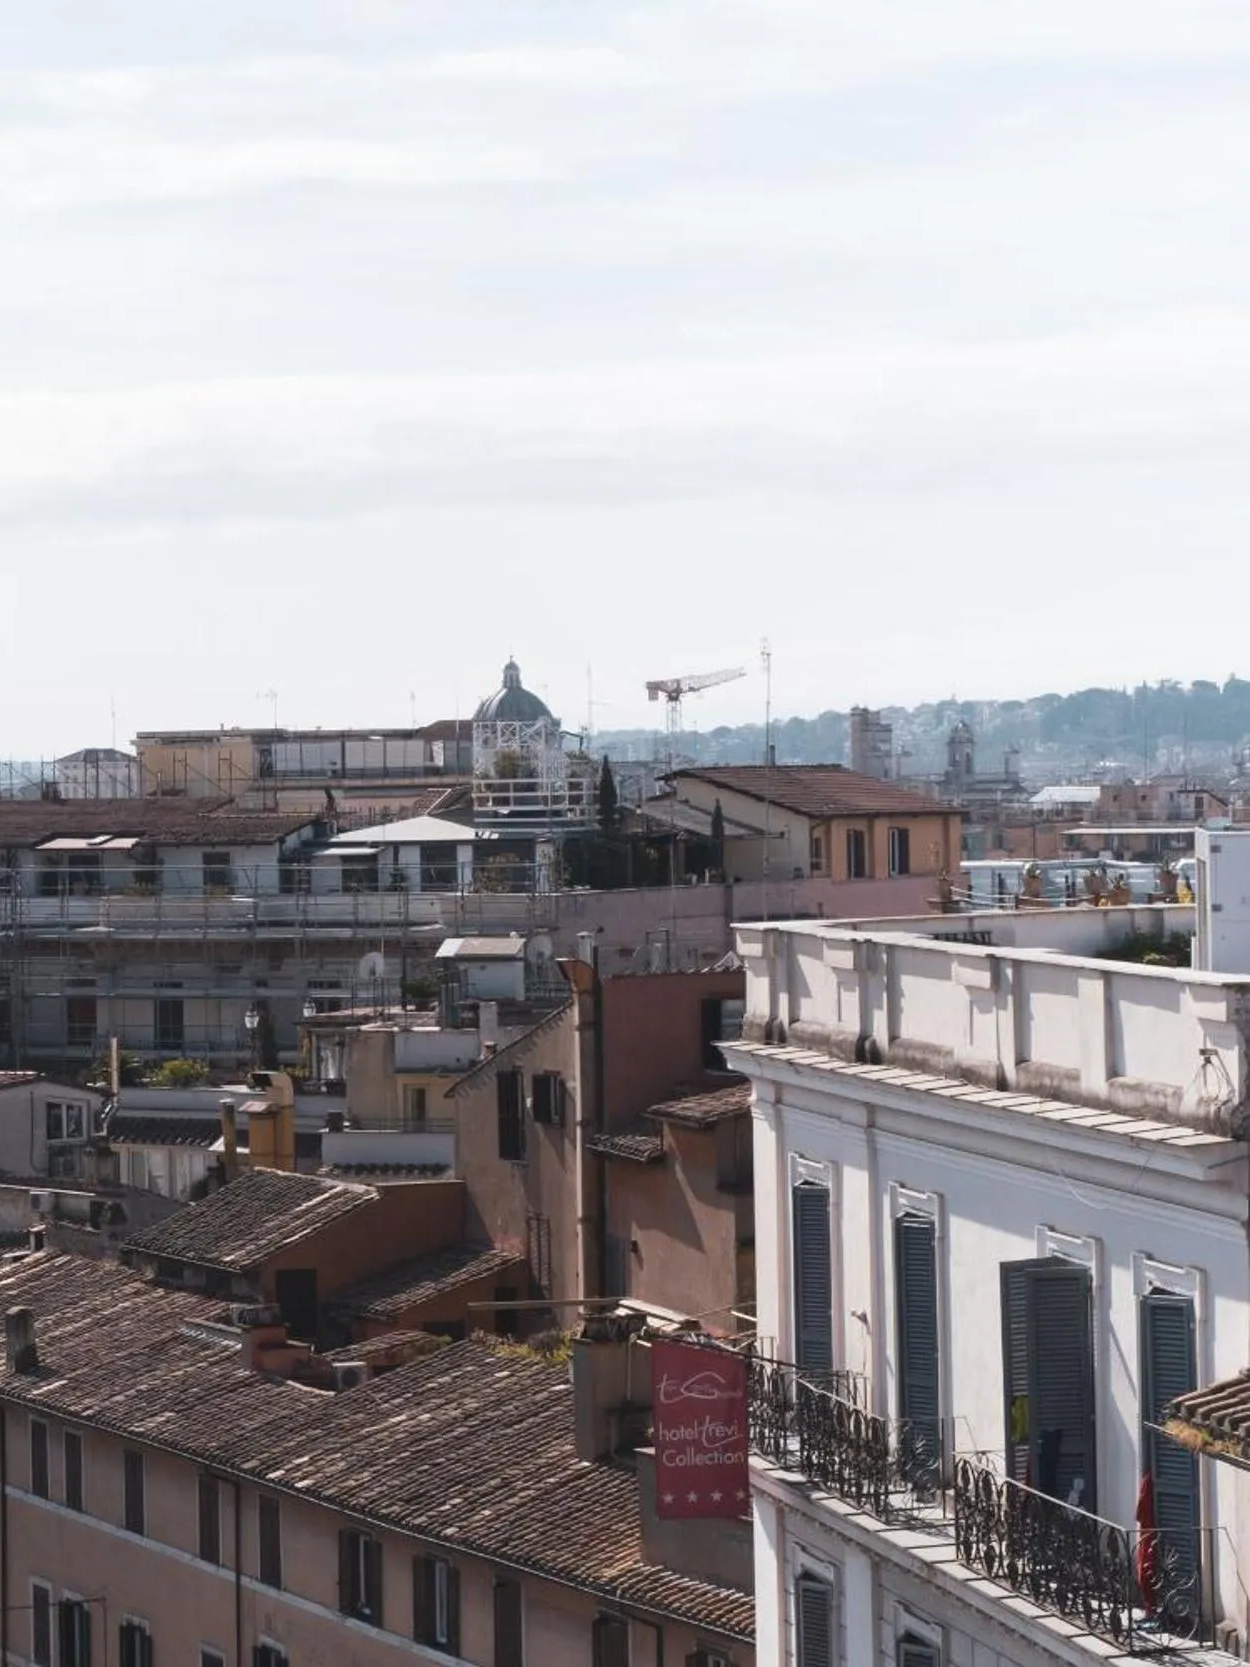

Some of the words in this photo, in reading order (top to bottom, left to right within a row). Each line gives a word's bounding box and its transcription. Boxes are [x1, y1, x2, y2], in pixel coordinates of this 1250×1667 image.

[659, 1419, 698, 1441] hotel
[698, 1415, 743, 1448] trevi
[663, 1446, 744, 1467] Collection
